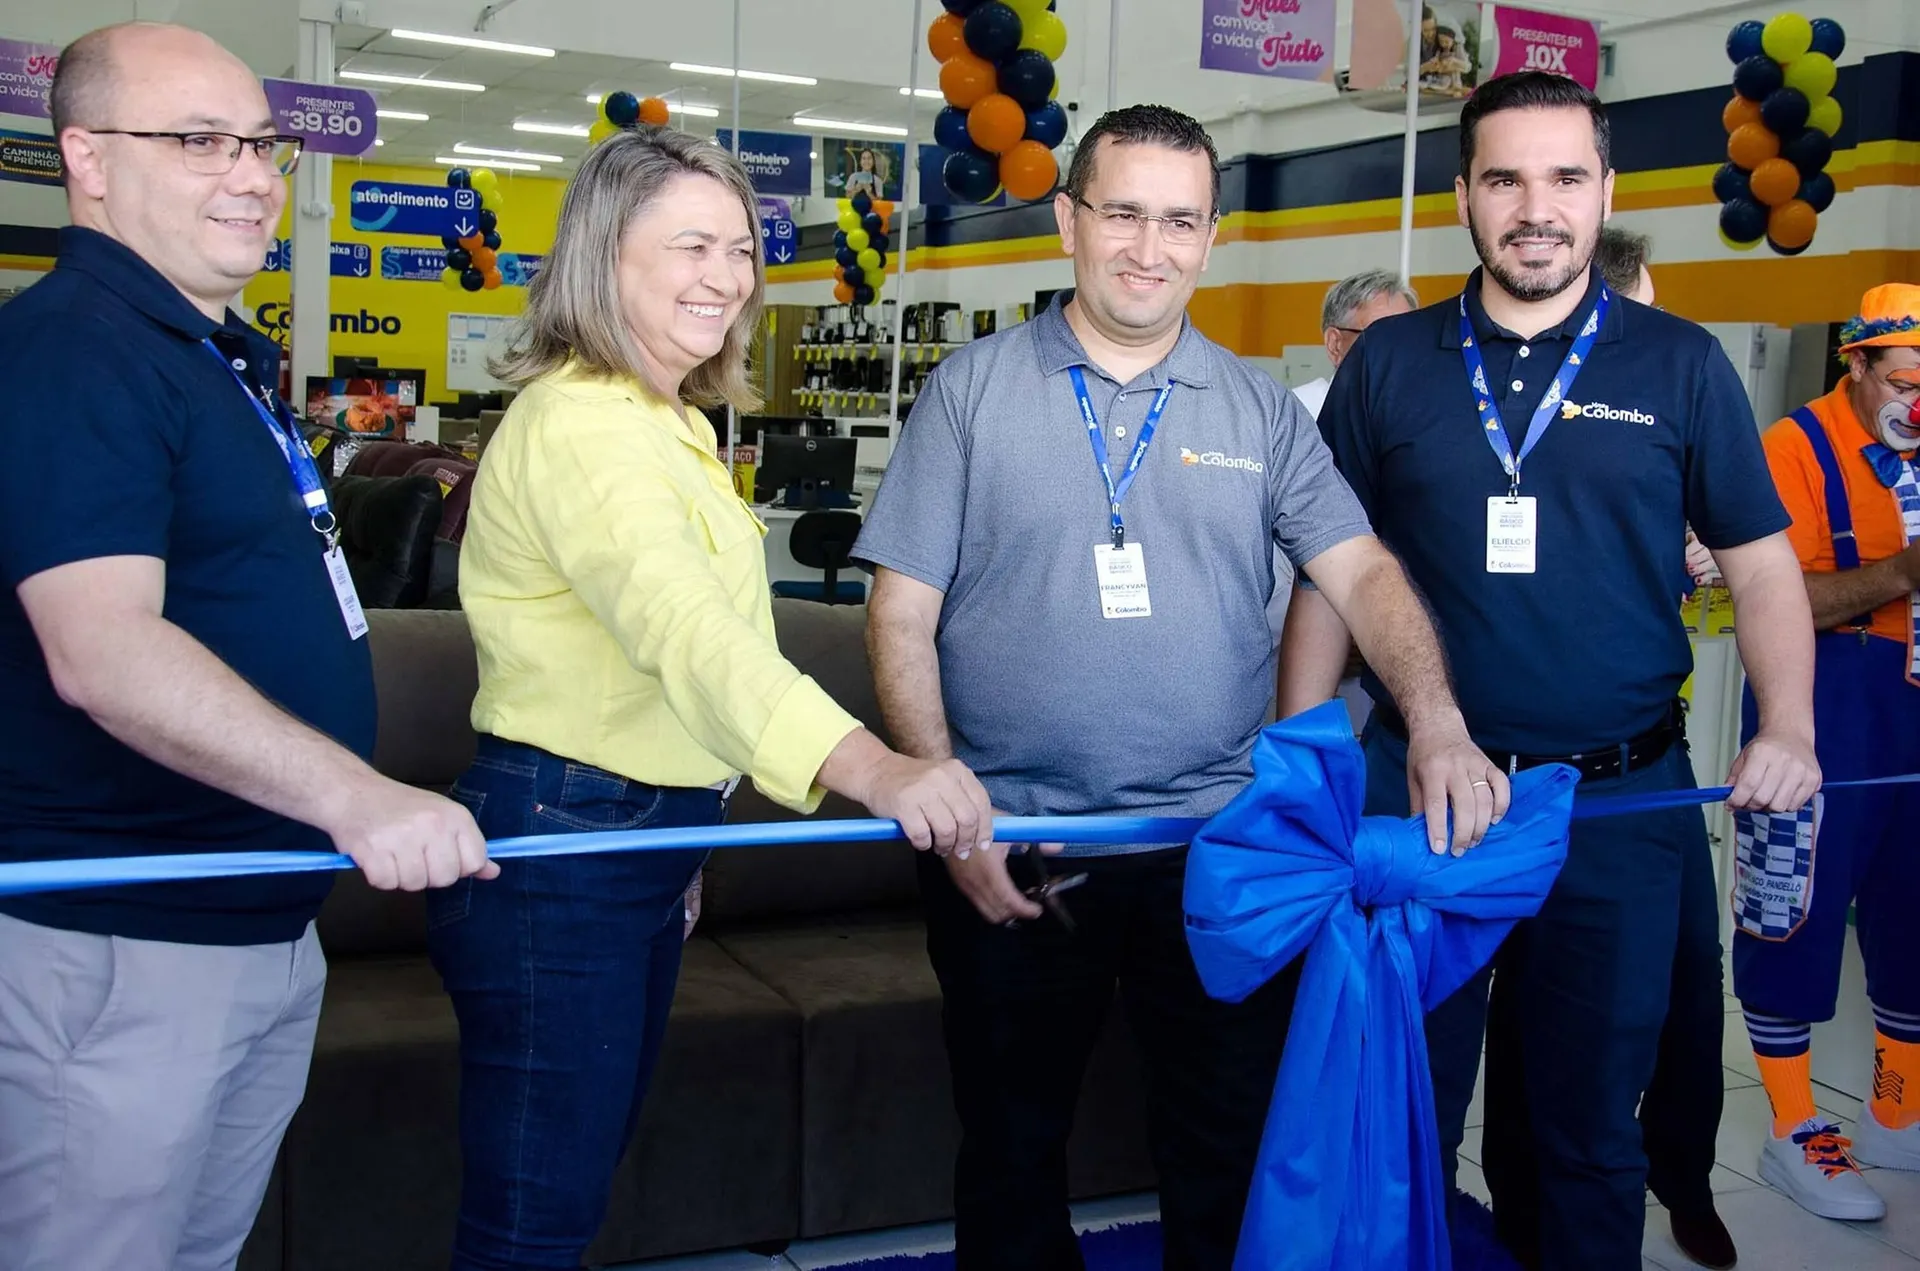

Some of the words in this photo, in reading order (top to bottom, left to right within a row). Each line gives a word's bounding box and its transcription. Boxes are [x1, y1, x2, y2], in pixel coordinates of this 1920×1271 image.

[1213, 15, 1241, 29] com
[1244, 19, 1275, 34] você
[1212, 33, 1223, 44] a
[1225, 32, 1253, 48] vida
[1512, 27, 1567, 46] PRESENTES
[1567, 35, 1582, 48] EM
[1261, 31, 1324, 67] Tudo
[1525, 44, 1567, 72] 10X
[0, 72, 27, 83] com
[9, 84, 38, 98] vida
[295, 96, 355, 111] PRESENTES
[289, 110, 363, 137] 39,90
[3, 147, 61, 161] CAMINHÃO
[13, 156, 61, 169] PRÊMIOS
[740, 152, 790, 166] Dinheiro
[756, 164, 782, 176] mão
[356, 189, 449, 209] atendimento
[1583, 404, 1655, 426] Colombo
[1200, 453, 1264, 473] Colombo
